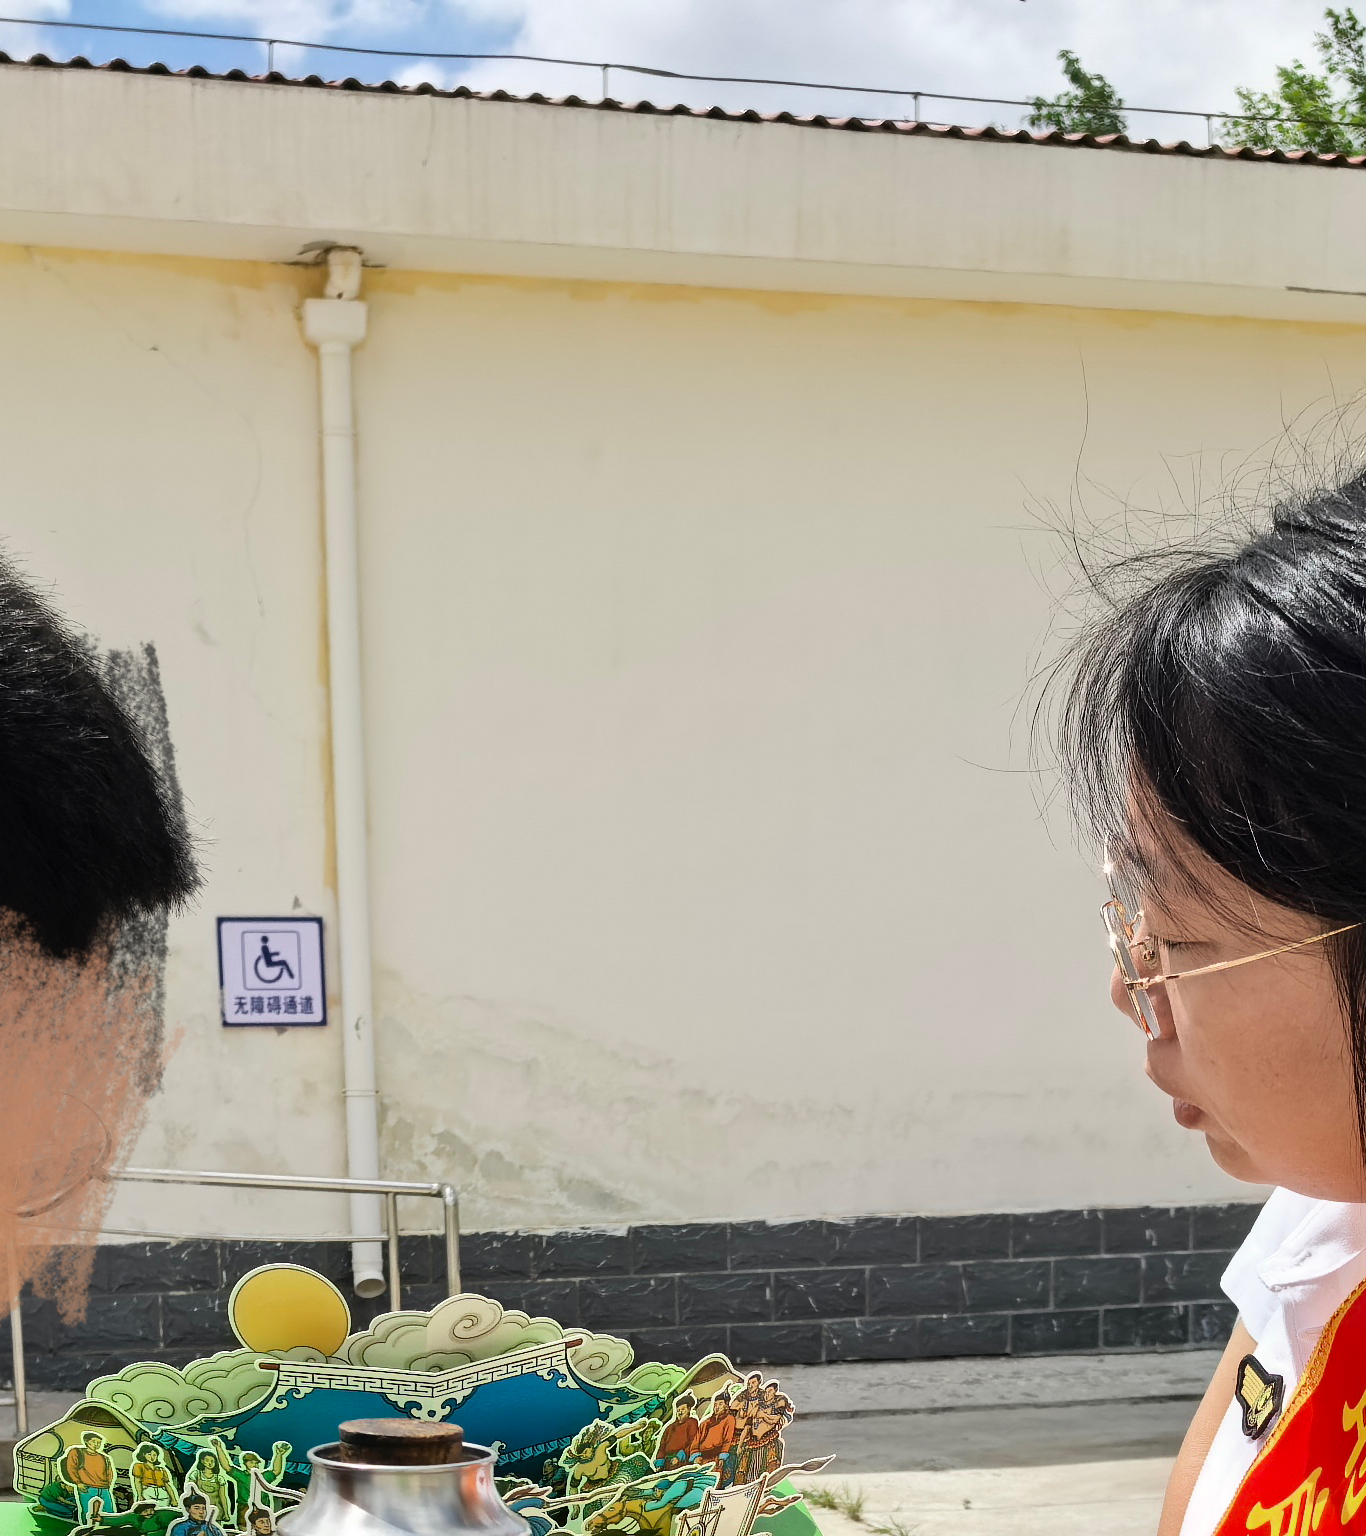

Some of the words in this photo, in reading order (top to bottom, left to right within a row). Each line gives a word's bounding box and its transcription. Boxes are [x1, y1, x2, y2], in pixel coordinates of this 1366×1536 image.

[233, 995, 314, 1016] 无障碍通道
